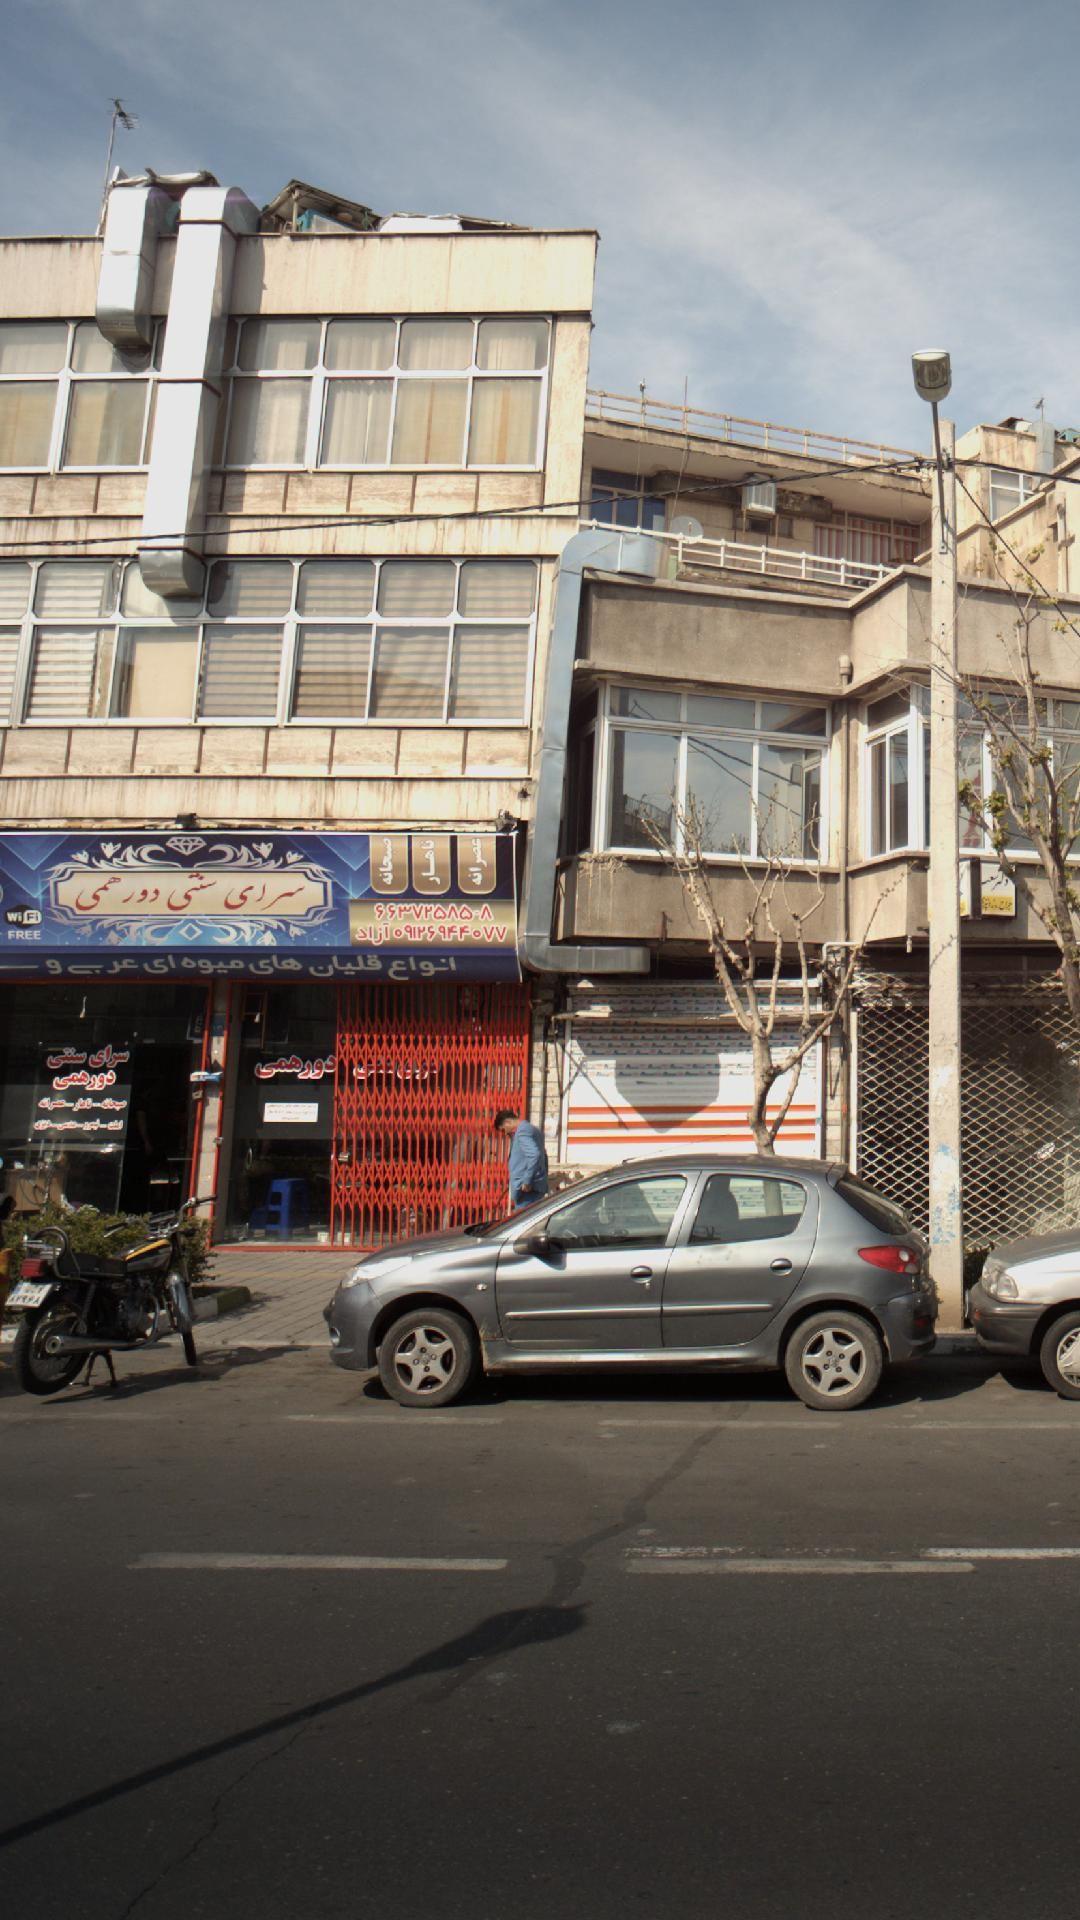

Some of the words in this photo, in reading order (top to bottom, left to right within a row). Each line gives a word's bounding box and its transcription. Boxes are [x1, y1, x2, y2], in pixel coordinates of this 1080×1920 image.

[379, 838, 393, 885] صبحانه
[468, 838, 487, 885] عصرانه
[167, 873, 216, 911] سنتی
[224, 883, 305, 911] سرای
[8, 930, 41, 940] FREE
[356, 923, 389, 945] آزاد
[45, 959, 63, 974] و
[249, 954, 302, 975] های
[309, 955, 382, 977] قلیان
[388, 956, 457, 980] انواع
[47, 1047, 87, 1069] سنتی
[89, 1044, 130, 1068] سرای
[53, 1070, 116, 1090] دورهمی
